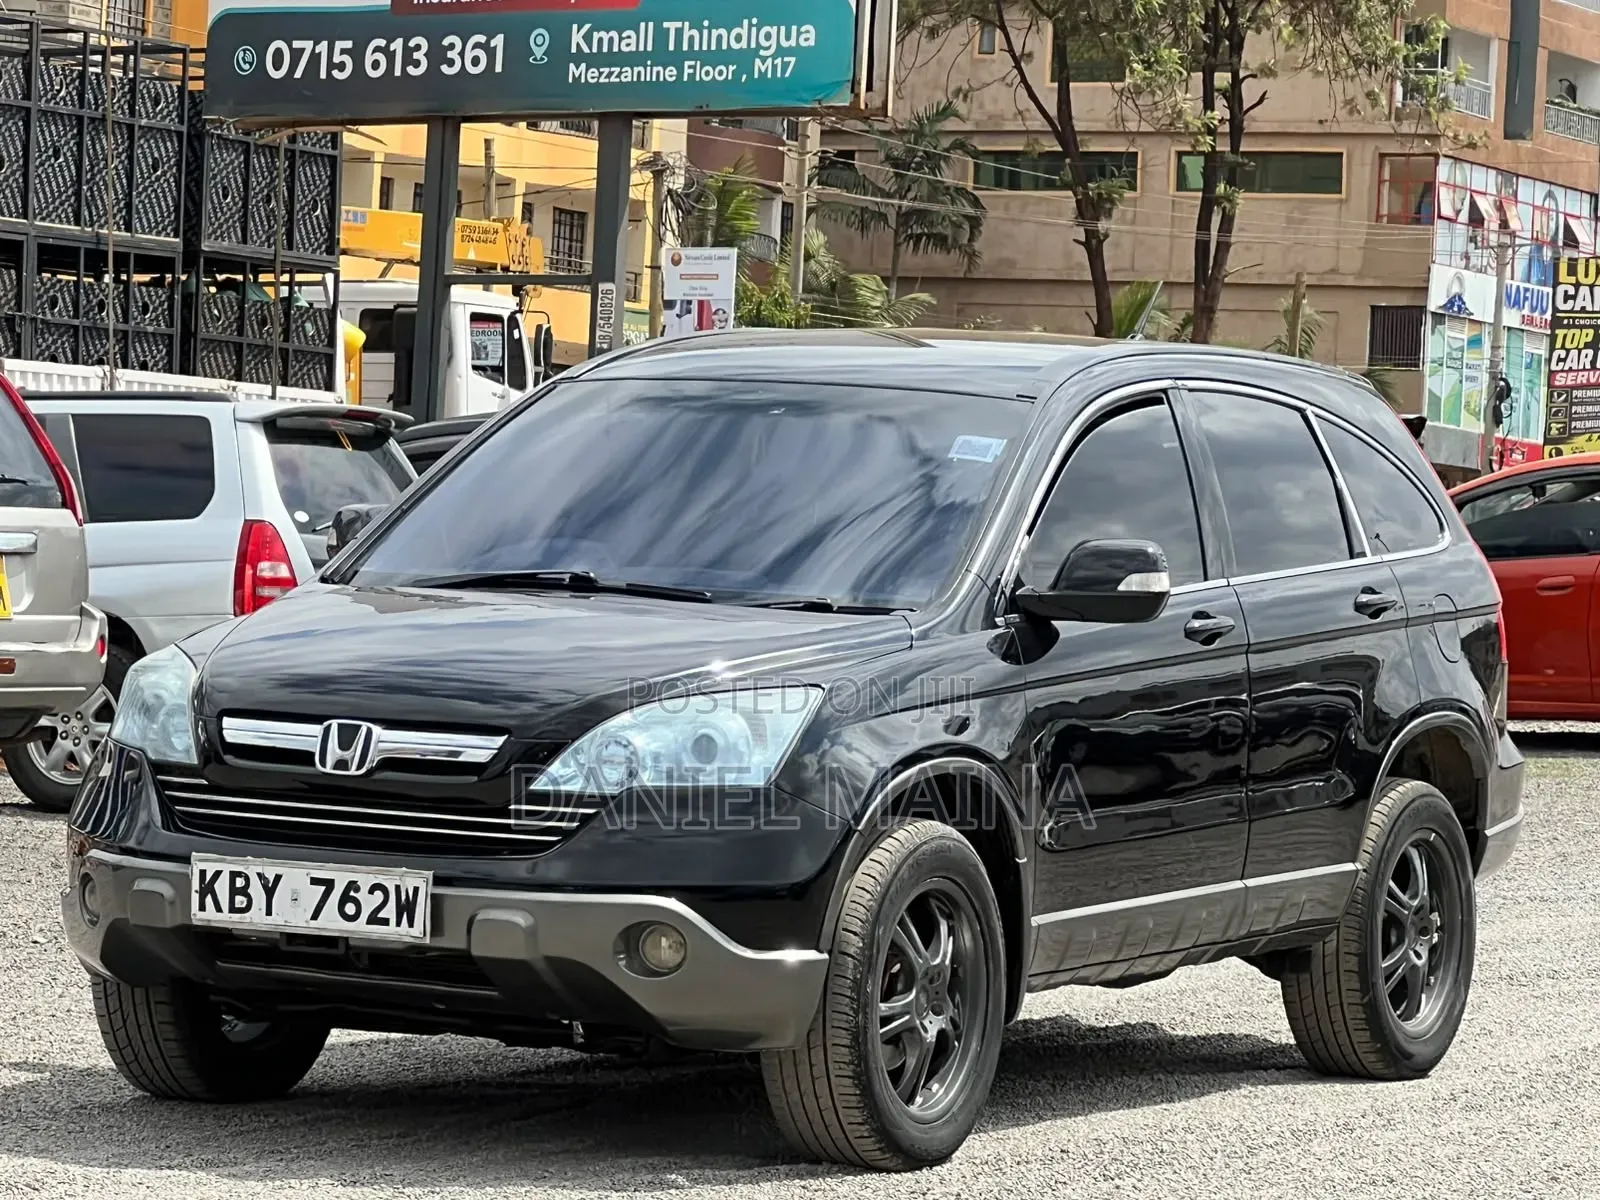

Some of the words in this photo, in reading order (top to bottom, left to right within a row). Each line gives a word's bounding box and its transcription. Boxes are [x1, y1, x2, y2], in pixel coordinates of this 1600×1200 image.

[570, 22, 654, 53] Kmall
[663, 18, 816, 56] Thindigua
[265, 40, 354, 80] 0715
[364, 36, 429, 78] 613
[439, 33, 505, 75] 361
[568, 61, 677, 84] Mezzanine
[683, 61, 737, 82] Floor
[753, 57, 796, 79] M17
[1558, 256, 1600, 285] LU
[1505, 283, 1549, 316] NAFUU
[1555, 328, 1594, 349] TOP
[1550, 349, 1594, 371] CAR
[1554, 371, 1600, 386] SERV
[1571, 420, 1600, 429] PREMIU
[198, 868, 284, 918] KBY
[309, 876, 420, 929] 762W
